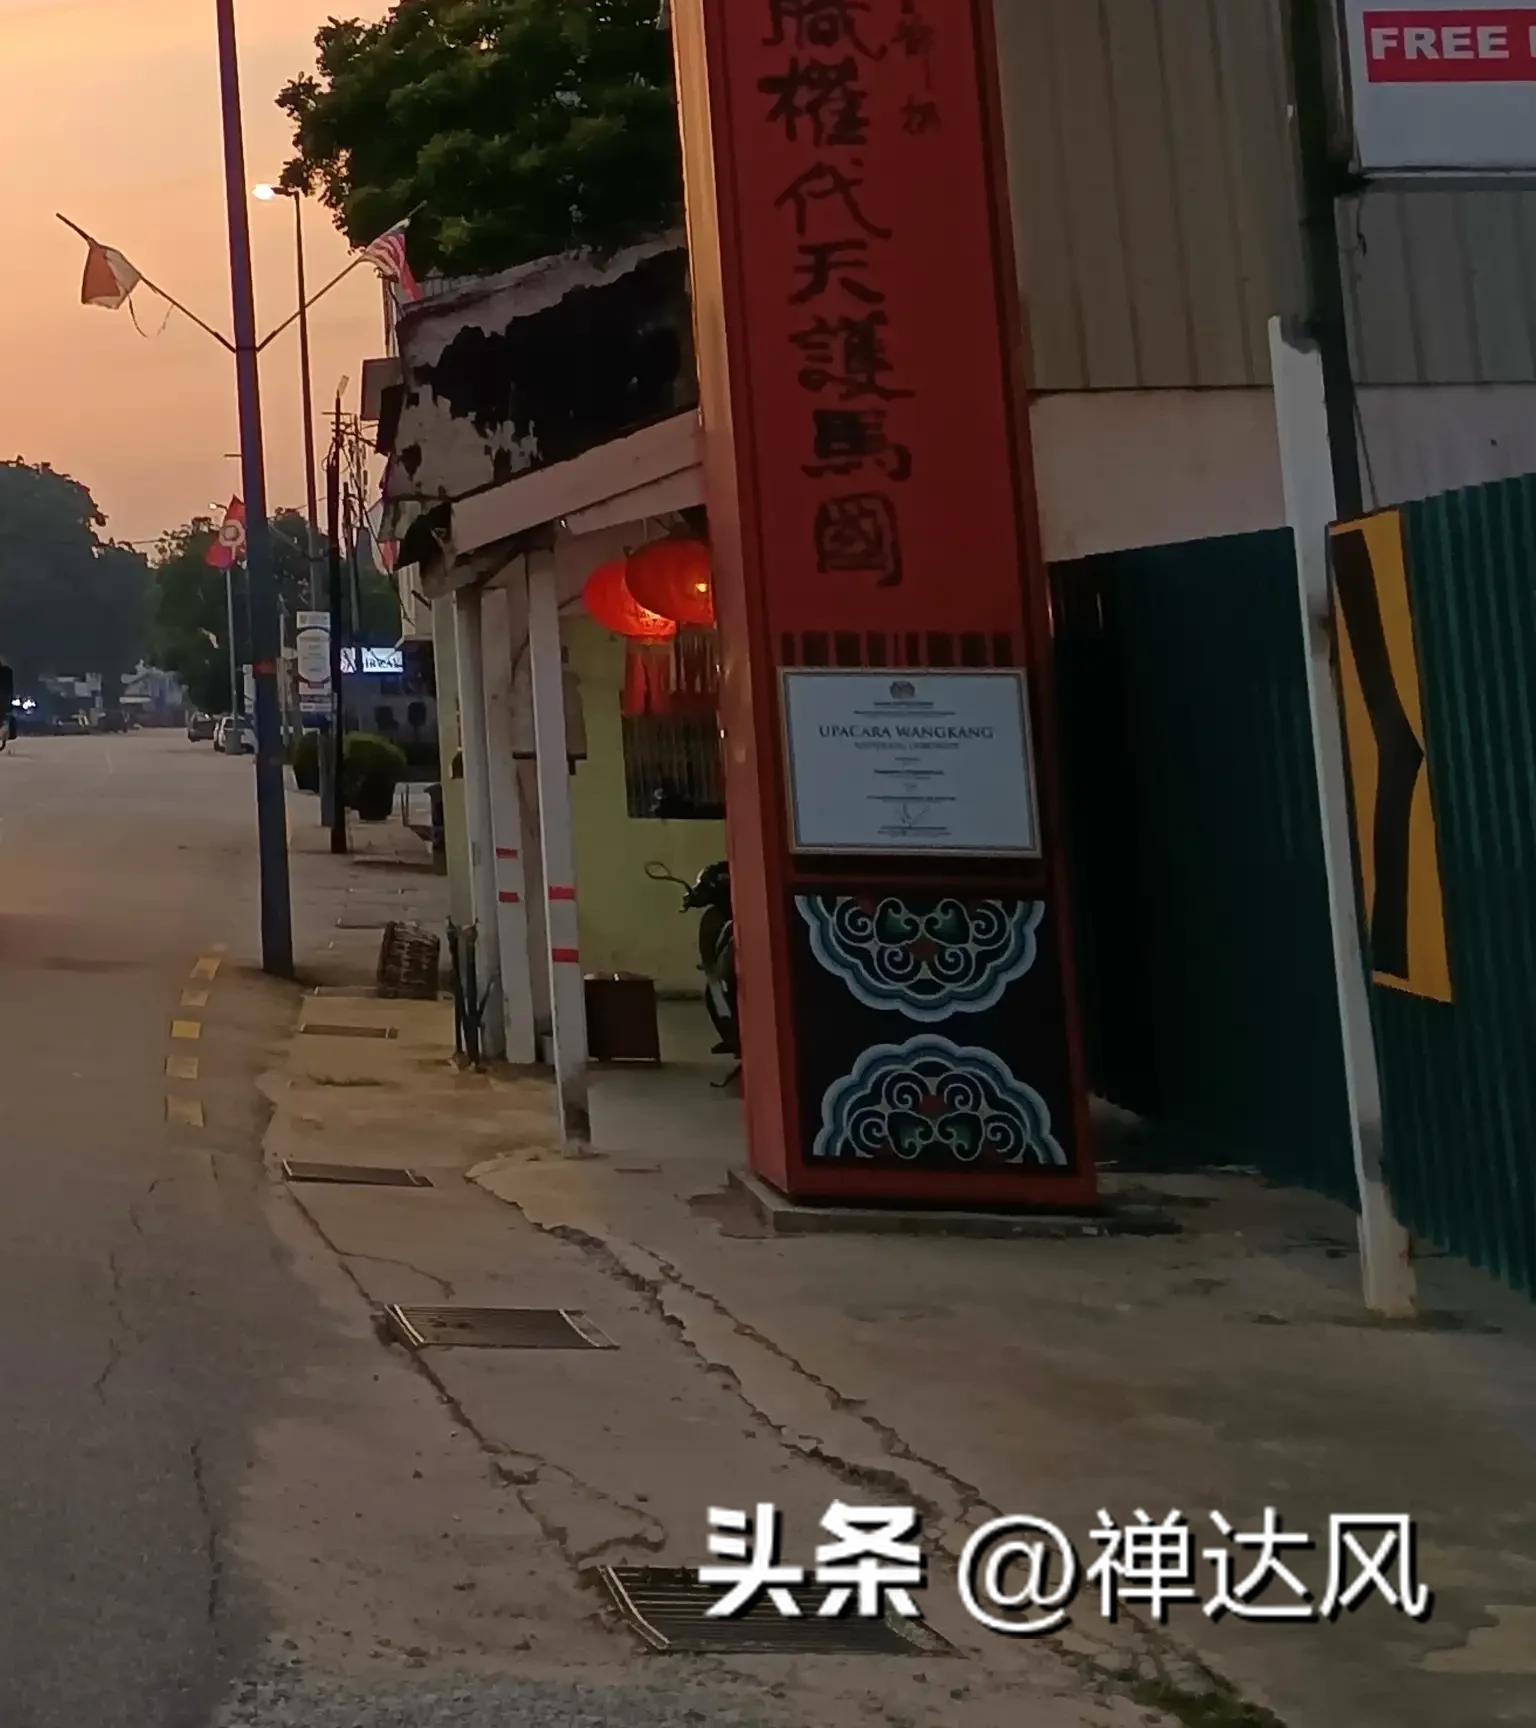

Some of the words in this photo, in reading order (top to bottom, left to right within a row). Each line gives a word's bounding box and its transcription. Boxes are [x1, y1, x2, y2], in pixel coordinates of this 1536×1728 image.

[1370, 25, 1510, 60] FREE
[819, 726, 892, 740] UPACARA
[895, 725, 995, 740] WANGKANG
